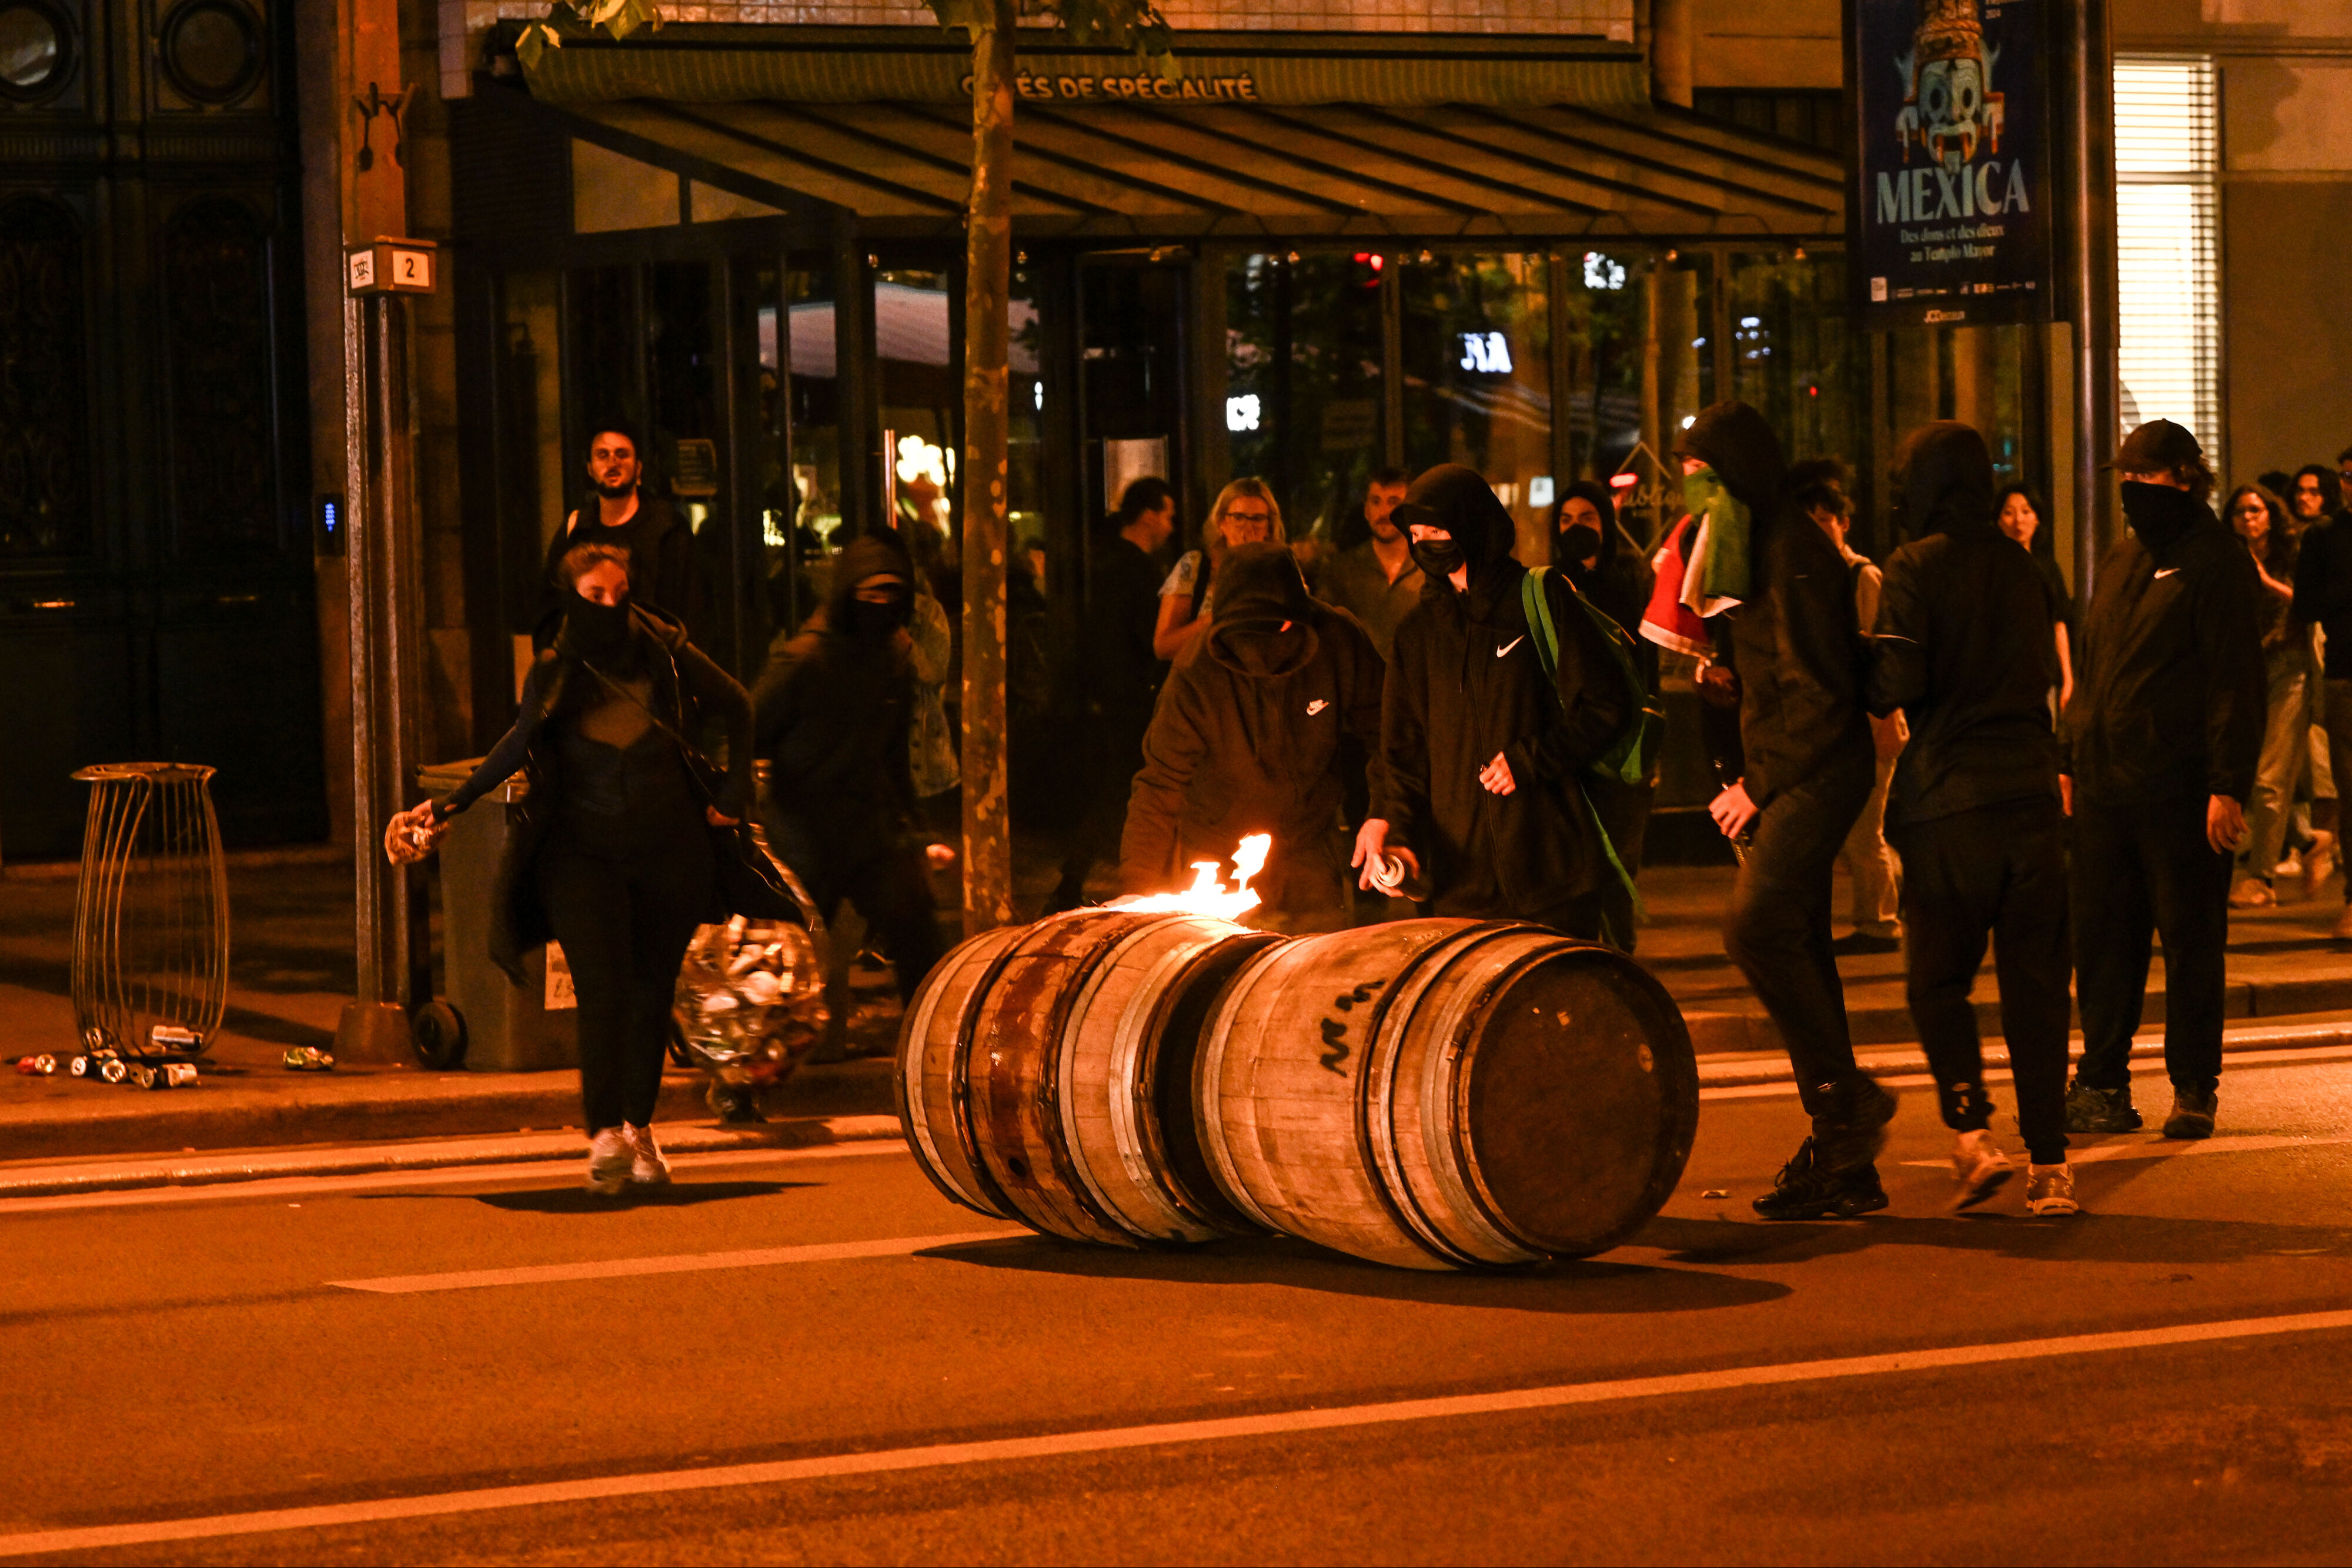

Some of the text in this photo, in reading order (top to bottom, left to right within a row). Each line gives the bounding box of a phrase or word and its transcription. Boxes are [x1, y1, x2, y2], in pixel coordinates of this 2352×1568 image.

[961, 70, 1054, 99] CÉS
[1059, 76, 1095, 99] DE
[1876, 158, 2029, 225] MEXICA
[405, 257, 415, 279] 2
